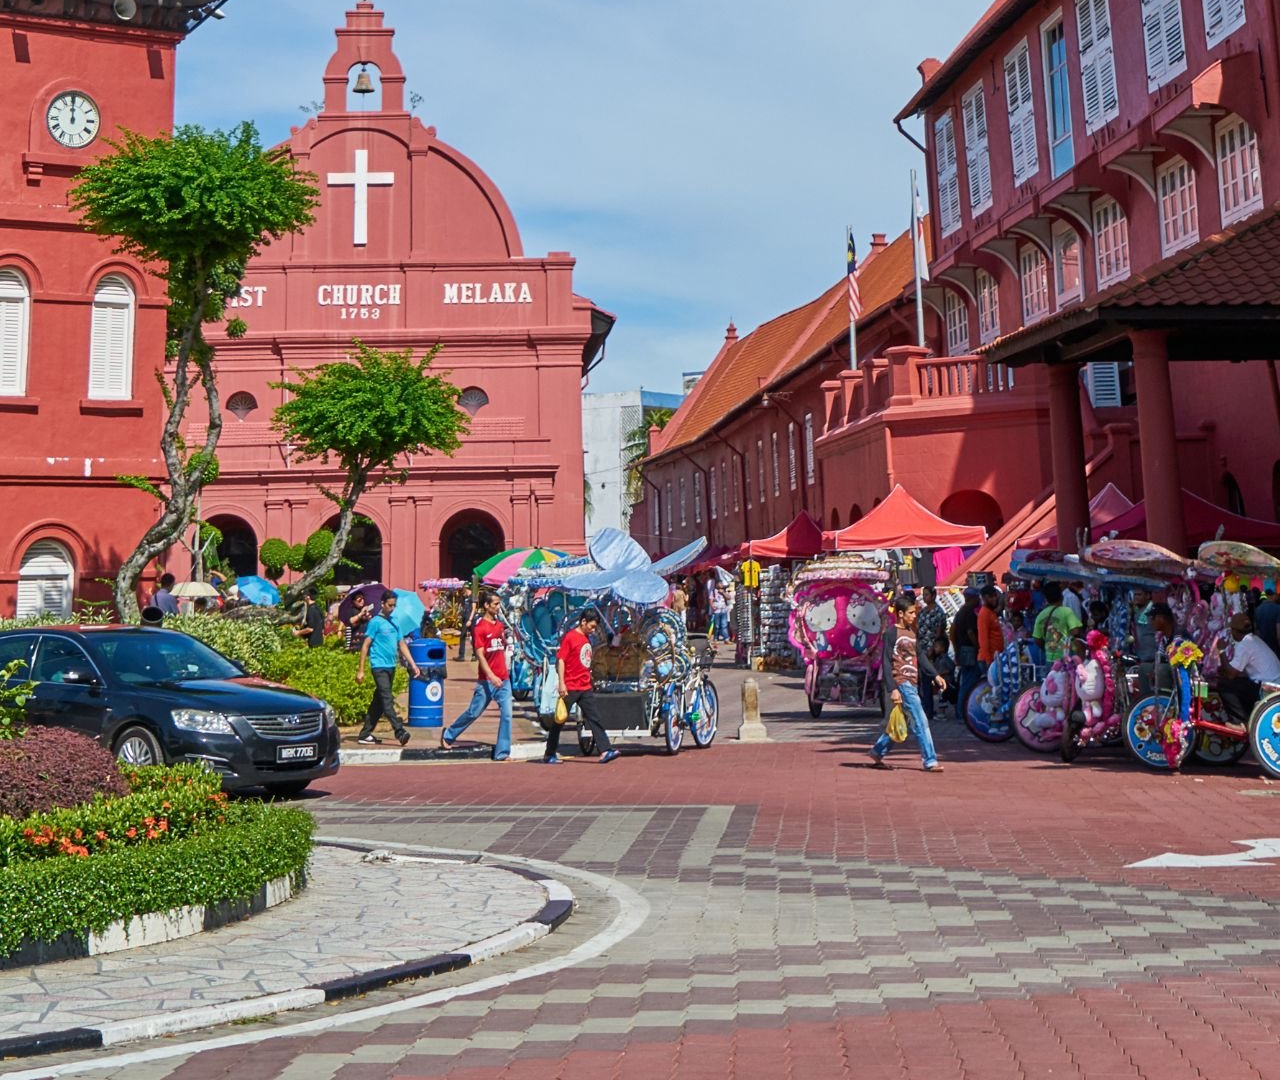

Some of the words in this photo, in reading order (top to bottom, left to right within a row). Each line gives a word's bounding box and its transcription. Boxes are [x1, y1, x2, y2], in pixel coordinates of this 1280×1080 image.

[318, 284, 401, 306] CHURCH
[443, 283, 533, 304] MELAKA
[340, 308, 380, 319] 1753
